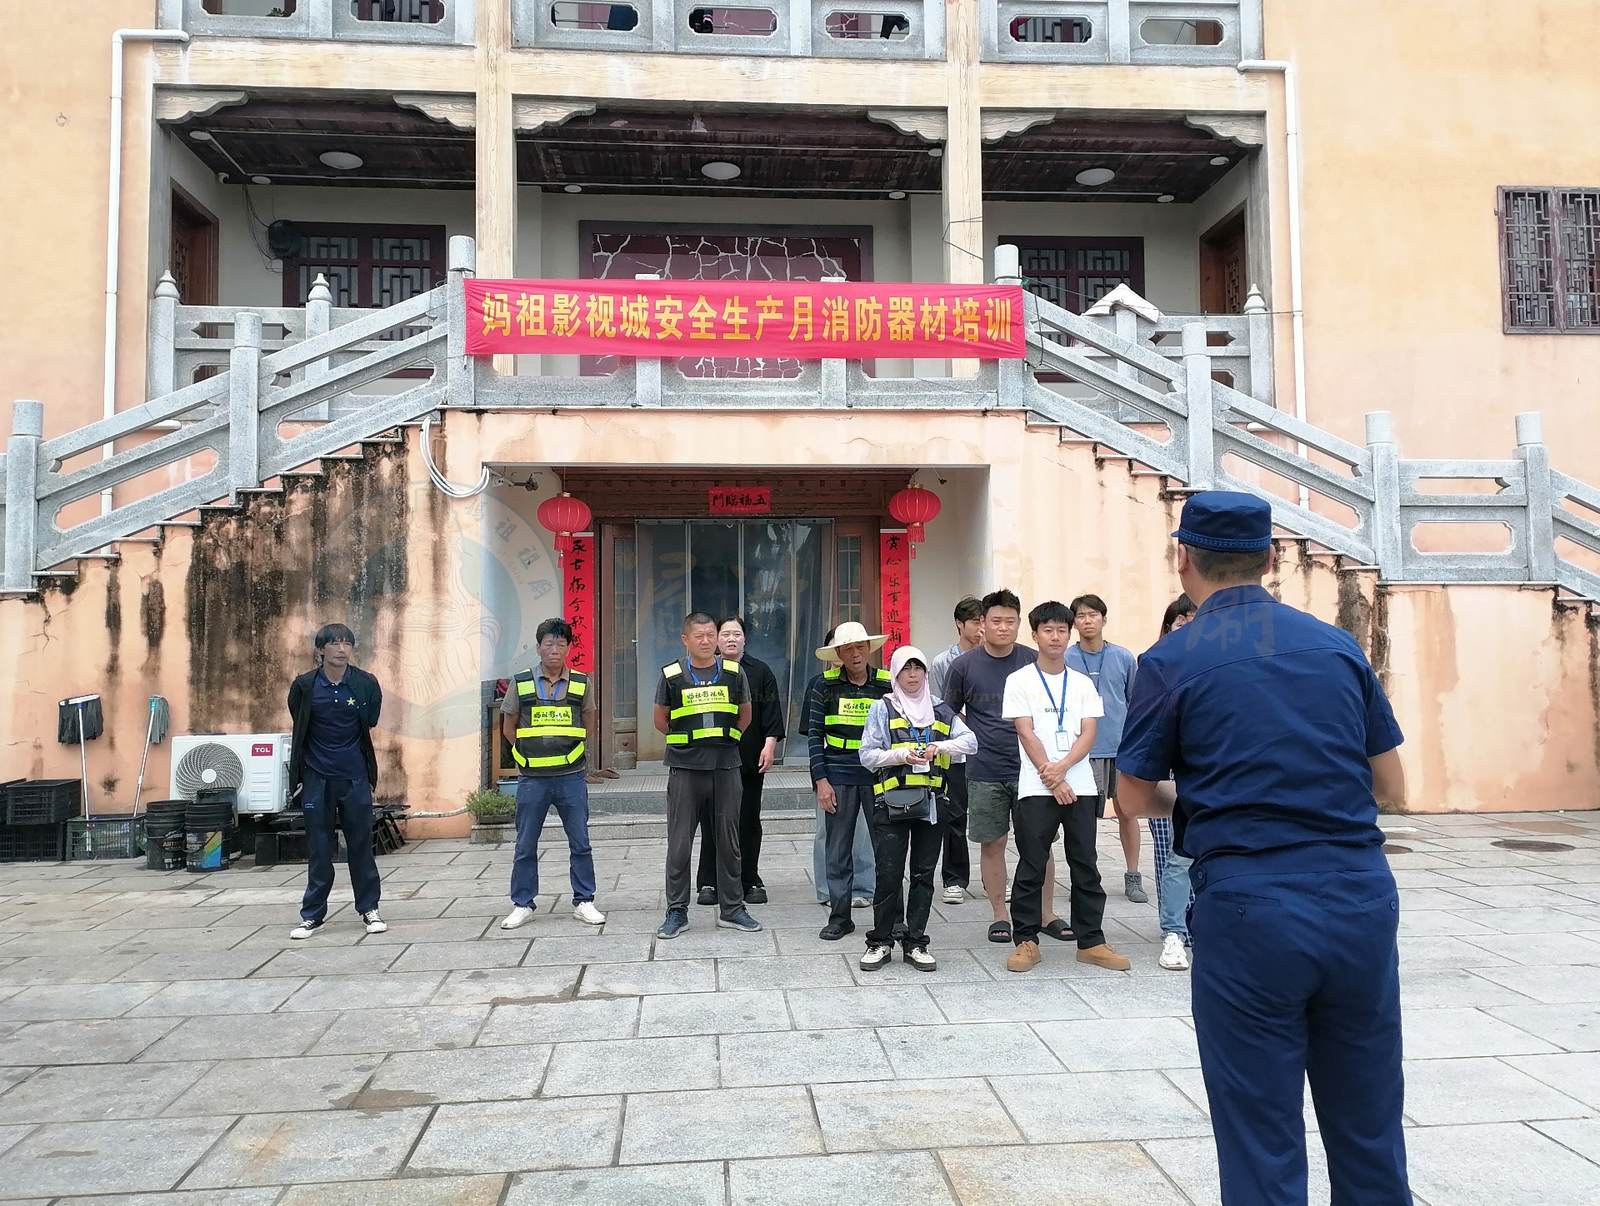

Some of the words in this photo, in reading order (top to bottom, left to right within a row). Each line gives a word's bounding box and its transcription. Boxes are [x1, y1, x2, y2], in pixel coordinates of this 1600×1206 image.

[481, 291, 1013, 343] 妈祖影视城安全生产月消防器材培训
